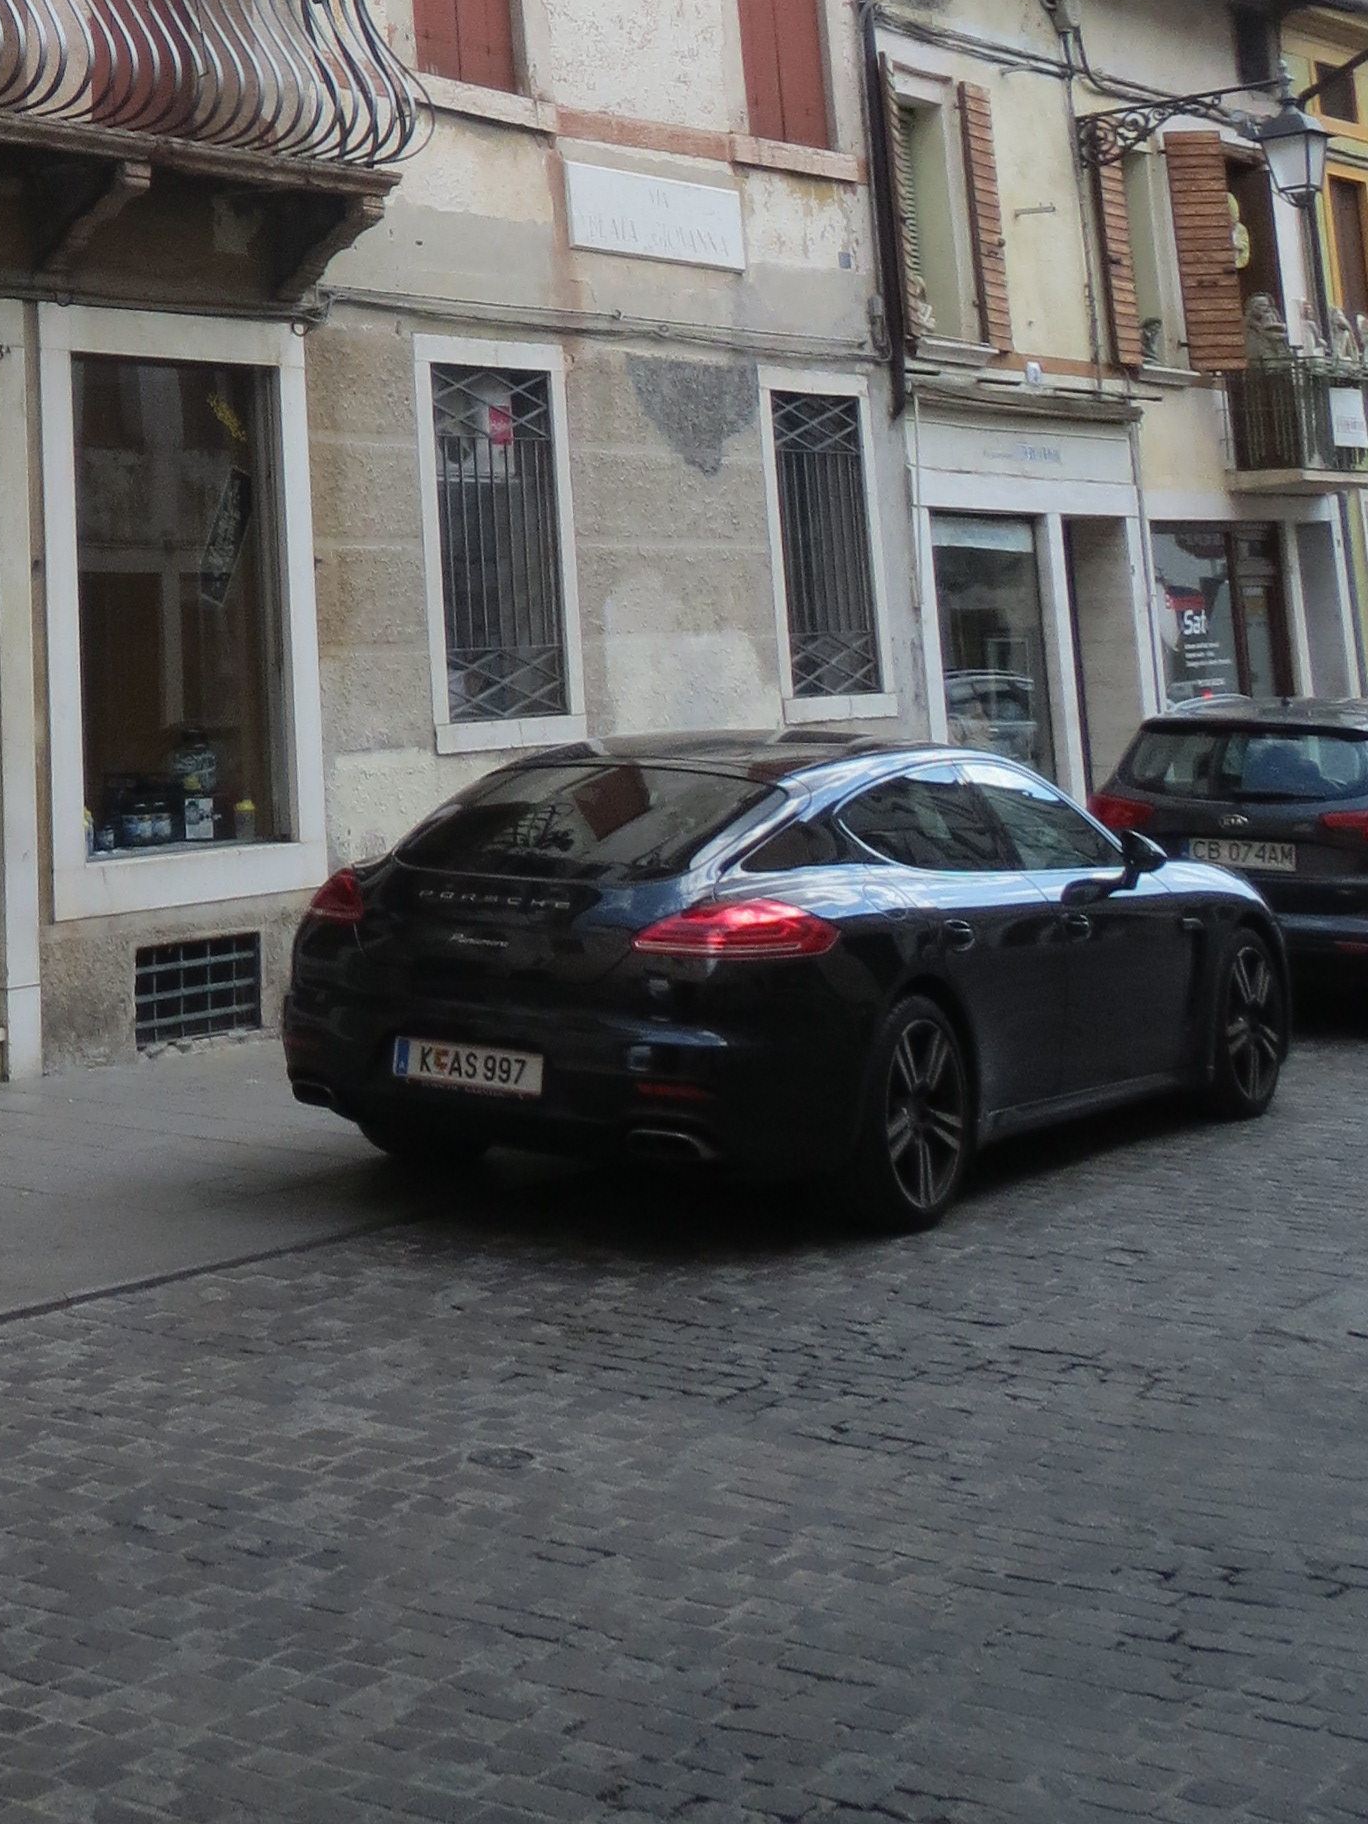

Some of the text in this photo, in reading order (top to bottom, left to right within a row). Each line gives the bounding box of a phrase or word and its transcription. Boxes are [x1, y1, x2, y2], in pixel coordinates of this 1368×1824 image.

[648, 188, 669, 208] VIA
[1183, 609, 1207, 636] Sat
[1193, 840, 1221, 860] CB
[419, 889, 571, 910] PORSCHE
[483, 1054, 527, 1085] 997
